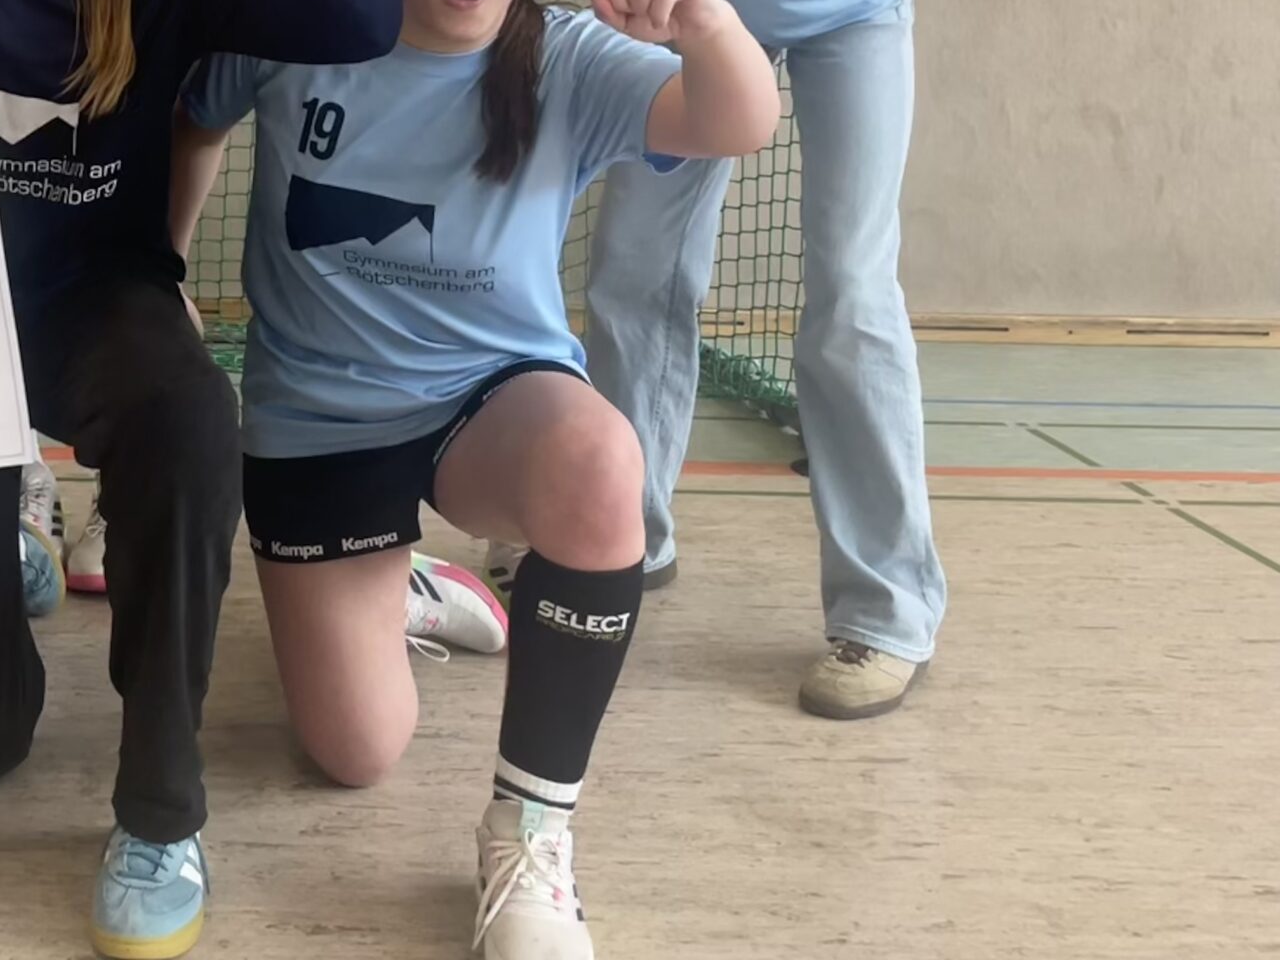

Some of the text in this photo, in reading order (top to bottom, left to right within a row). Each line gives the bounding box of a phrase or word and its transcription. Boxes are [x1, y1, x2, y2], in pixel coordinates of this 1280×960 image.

[297, 96, 346, 161] 19
[89, 159, 122, 179] am
[343, 248, 496, 279] Gymnasium am
[271, 540, 324, 561] Kempa
[340, 530, 399, 553] Kempa
[536, 599, 631, 633] SELECT
